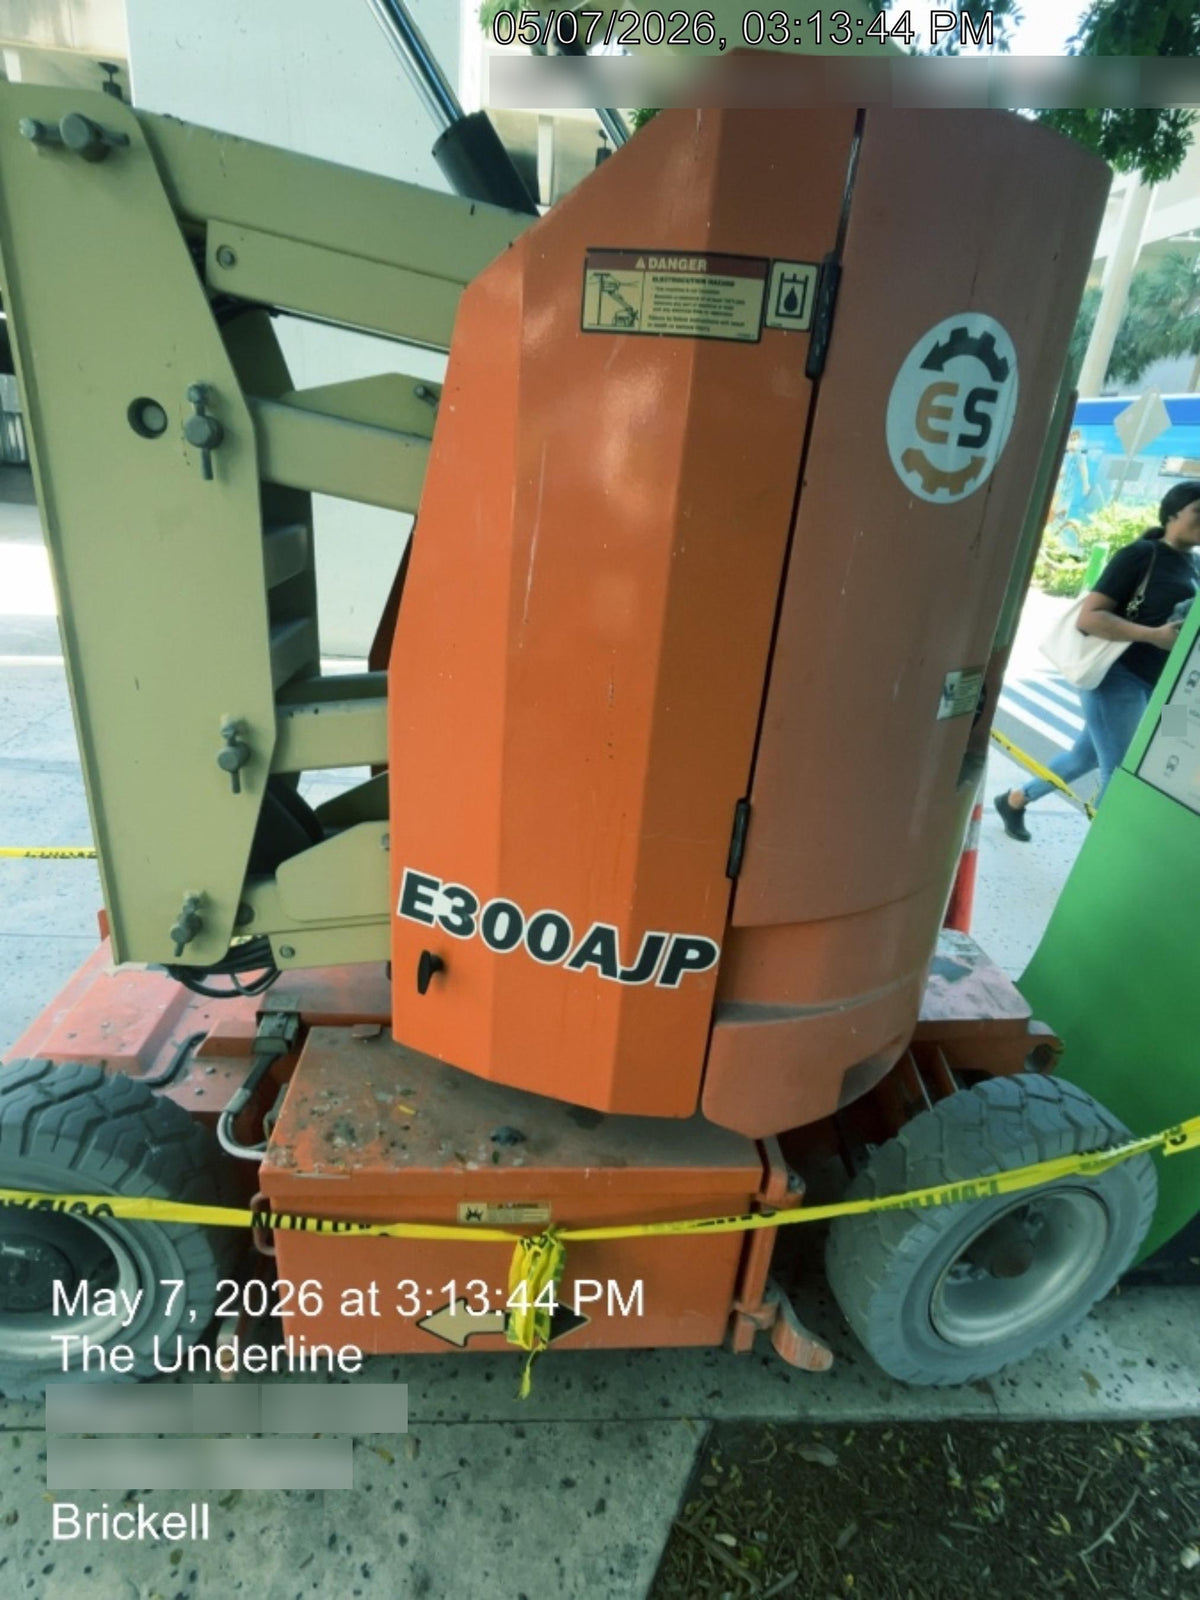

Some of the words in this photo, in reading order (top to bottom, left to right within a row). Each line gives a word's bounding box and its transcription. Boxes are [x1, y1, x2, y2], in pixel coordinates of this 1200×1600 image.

[648, 257, 707, 272] DANGER
[915, 380, 999, 449] ES
[397, 867, 719, 989] E300AJP
